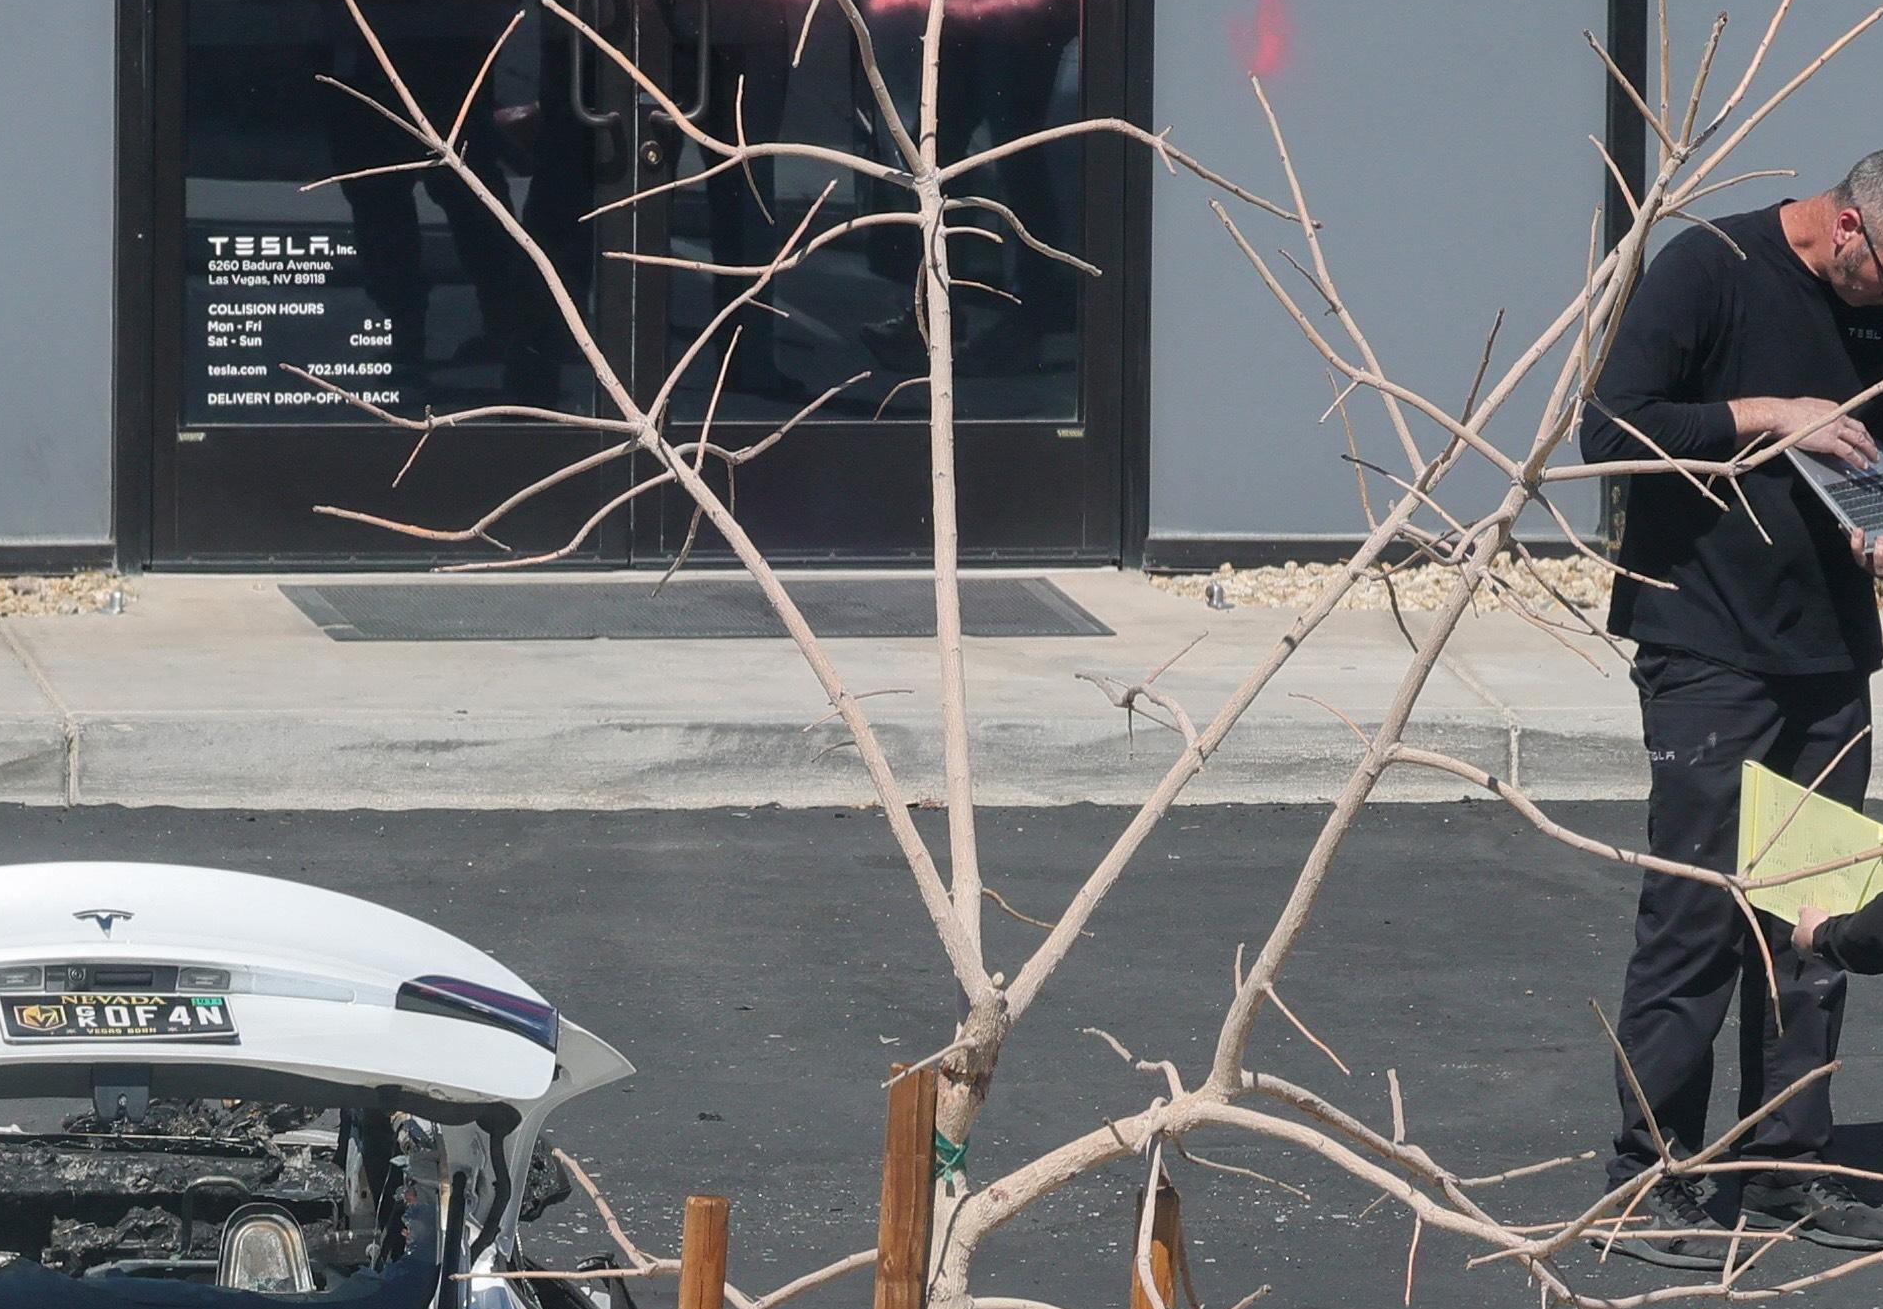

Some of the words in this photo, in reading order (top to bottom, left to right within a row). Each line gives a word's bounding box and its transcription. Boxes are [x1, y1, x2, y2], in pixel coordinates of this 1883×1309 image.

[337, 244, 357, 255] Inc.
[208, 260, 239, 271] 6260
[242, 260, 284, 271] Badura
[208, 274, 228, 285] Las
[231, 274, 271, 286] Vegas,
[273, 274, 291, 284] NV
[294, 274, 325, 284] 89118
[208, 304, 276, 315] COLLISION
[279, 304, 324, 314] HOURS
[208, 321, 234, 332] Mon
[245, 320, 262, 331] Fri
[364, 319, 372, 330] 8
[384, 319, 392, 330] 5
[208, 335, 228, 346] Sat
[239, 335, 262, 346] Sun
[349, 334, 392, 346] Closed
[208, 364, 267, 376] tesla.com
[307, 363, 392, 375] 702.914.6500
[208, 392, 270, 405] DELIVERY
[363, 391, 399, 404] BACK
[61, 995, 167, 1005] NEVADA
